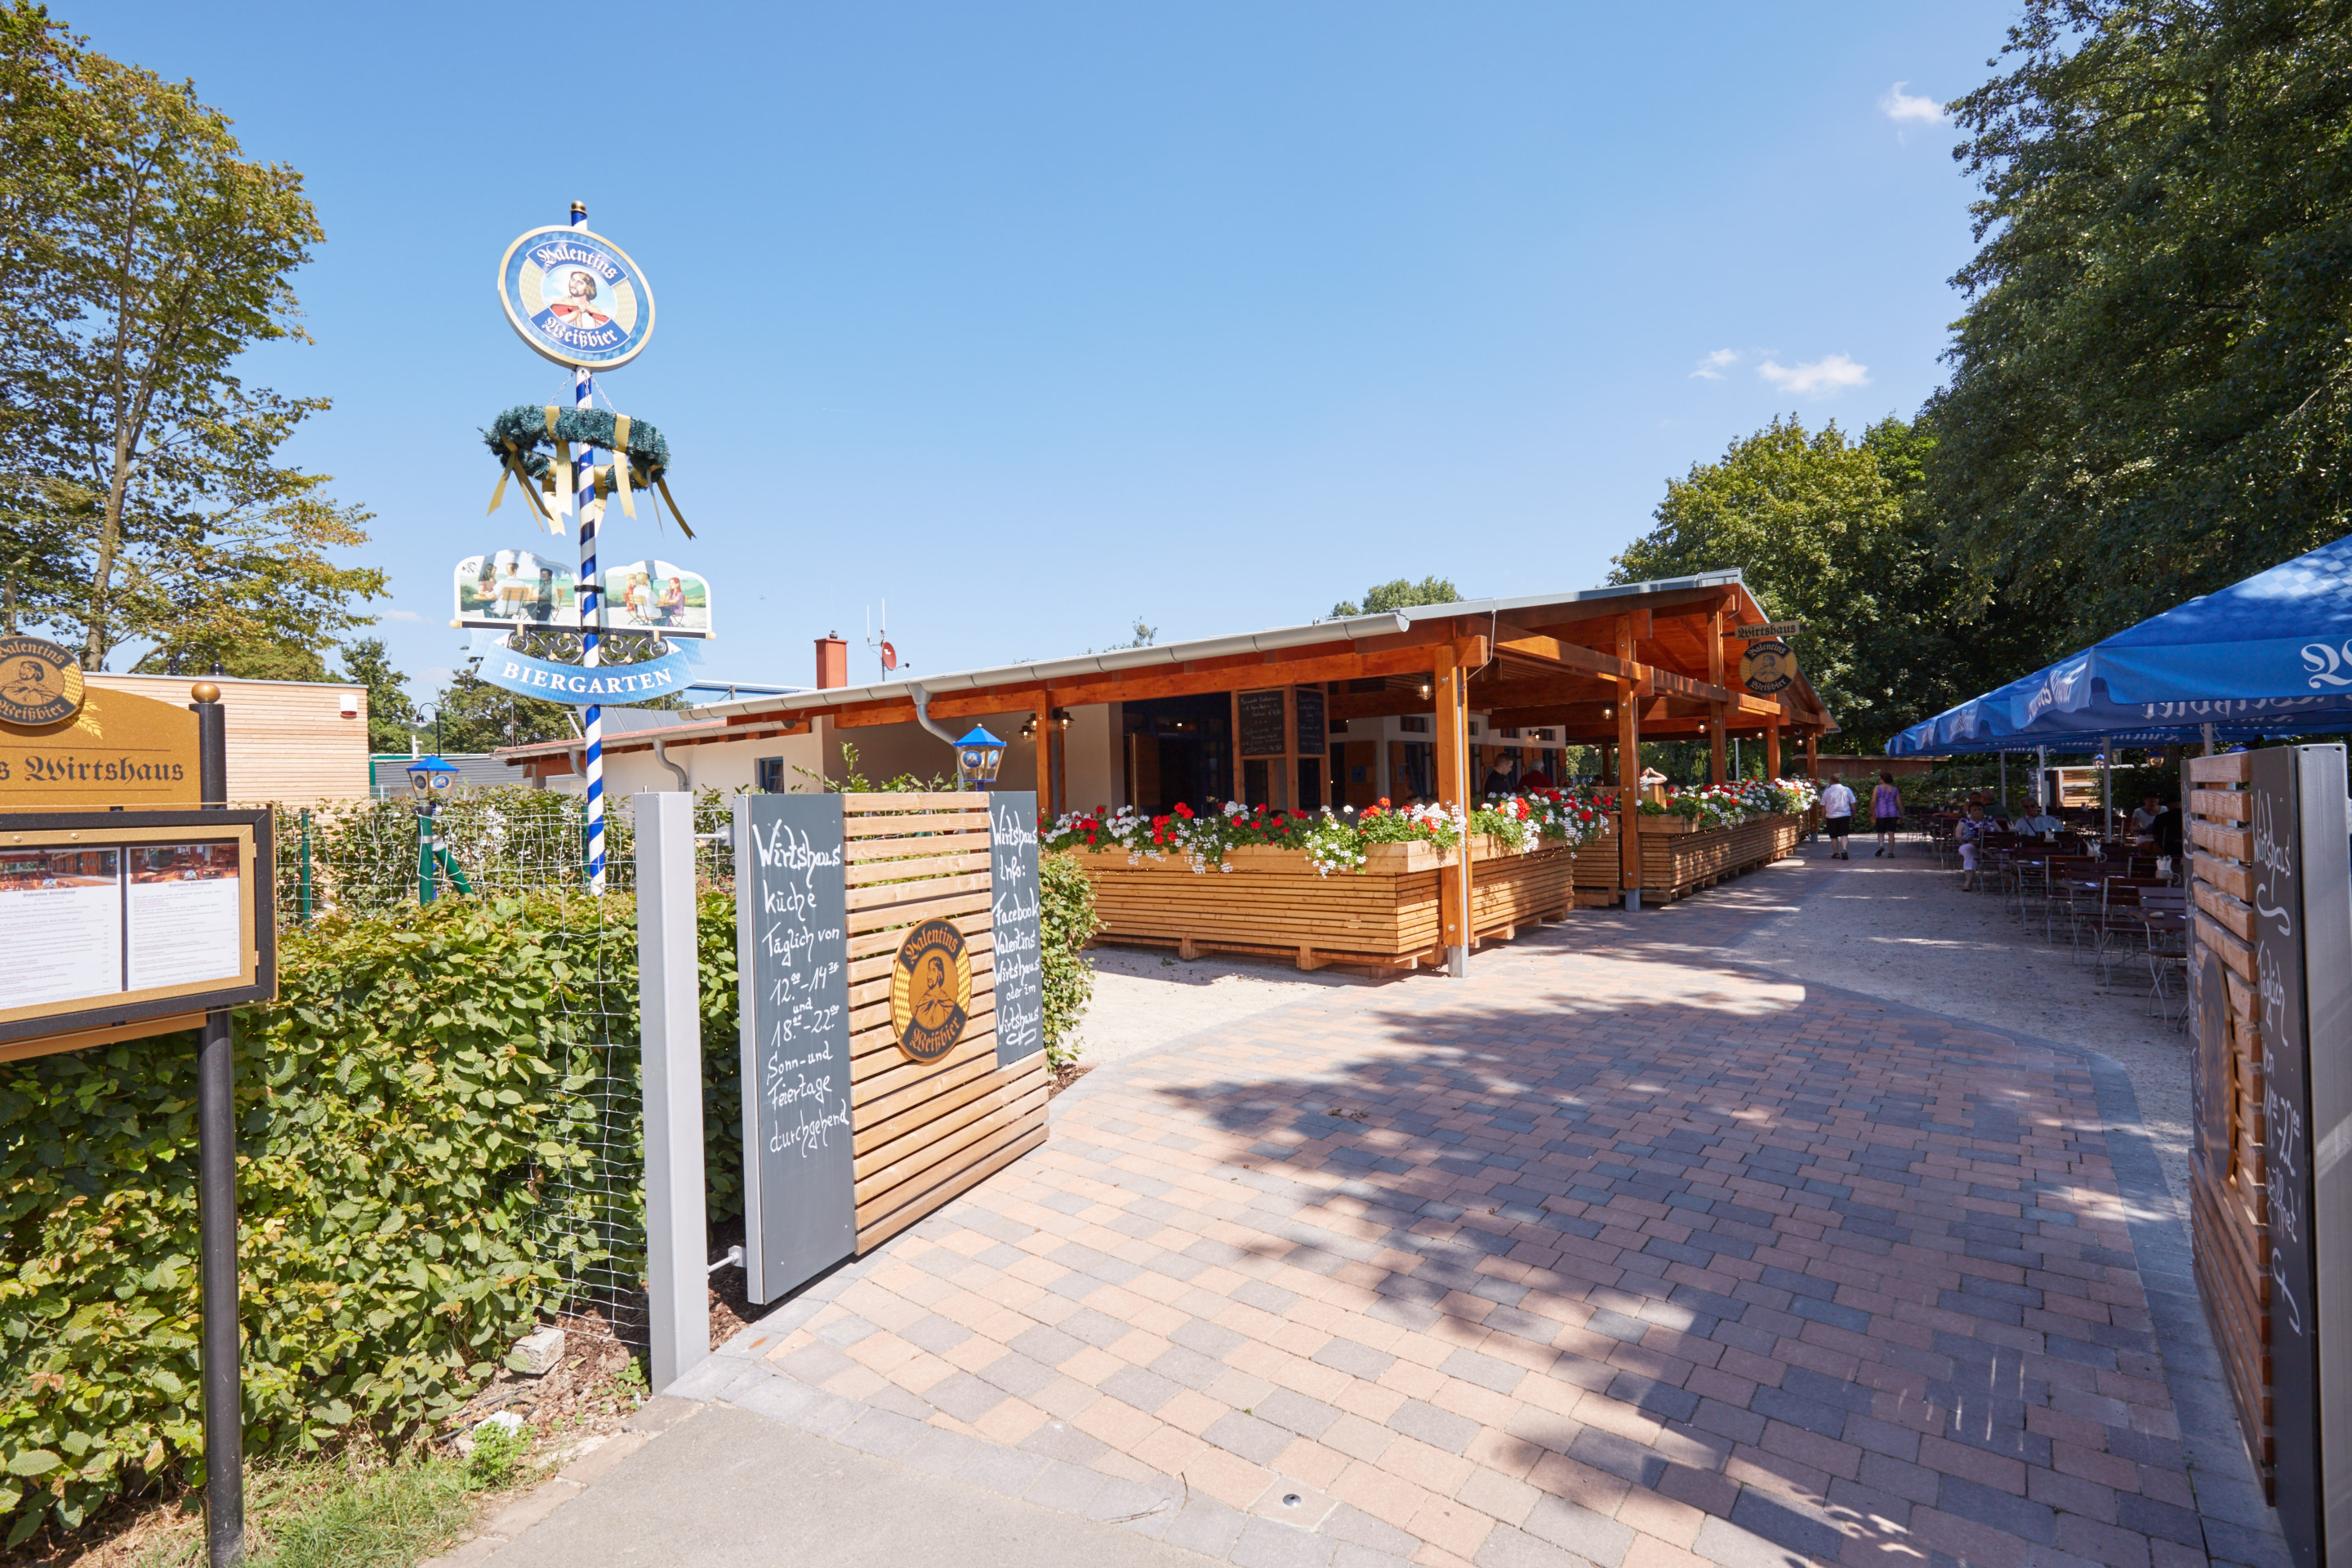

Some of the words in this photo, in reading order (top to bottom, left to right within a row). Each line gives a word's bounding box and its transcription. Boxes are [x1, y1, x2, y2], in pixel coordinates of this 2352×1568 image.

[537, 243, 618, 279] Valentins
[541, 316, 618, 349] Weißbier
[1738, 624, 1796, 639] Wirtshaus
[1748, 643, 1787, 658] Valentins
[501, 661, 672, 694] BIERGARTEN
[24, 755, 184, 785] Wirtshaus
[989, 804, 1038, 857] Wirtshaus
[752, 818, 840, 889] Wirtshaus
[991, 887, 1040, 926] Facebook
[817, 928, 840, 942] von
[905, 926, 959, 964] Valentins
[993, 928, 1036, 956] Valentins
[993, 953, 1040, 986] Wirtshaus
[793, 997, 813, 1013] und
[1006, 983, 1022, 1001] oder
[1024, 983, 1036, 996] im
[910, 1016, 960, 1053] Weißbier
[996, 1003, 1039, 1036] Wirtshaus
[768, 1073, 833, 1111] Feiertage
[770, 1098, 849, 1158] durchgehend
